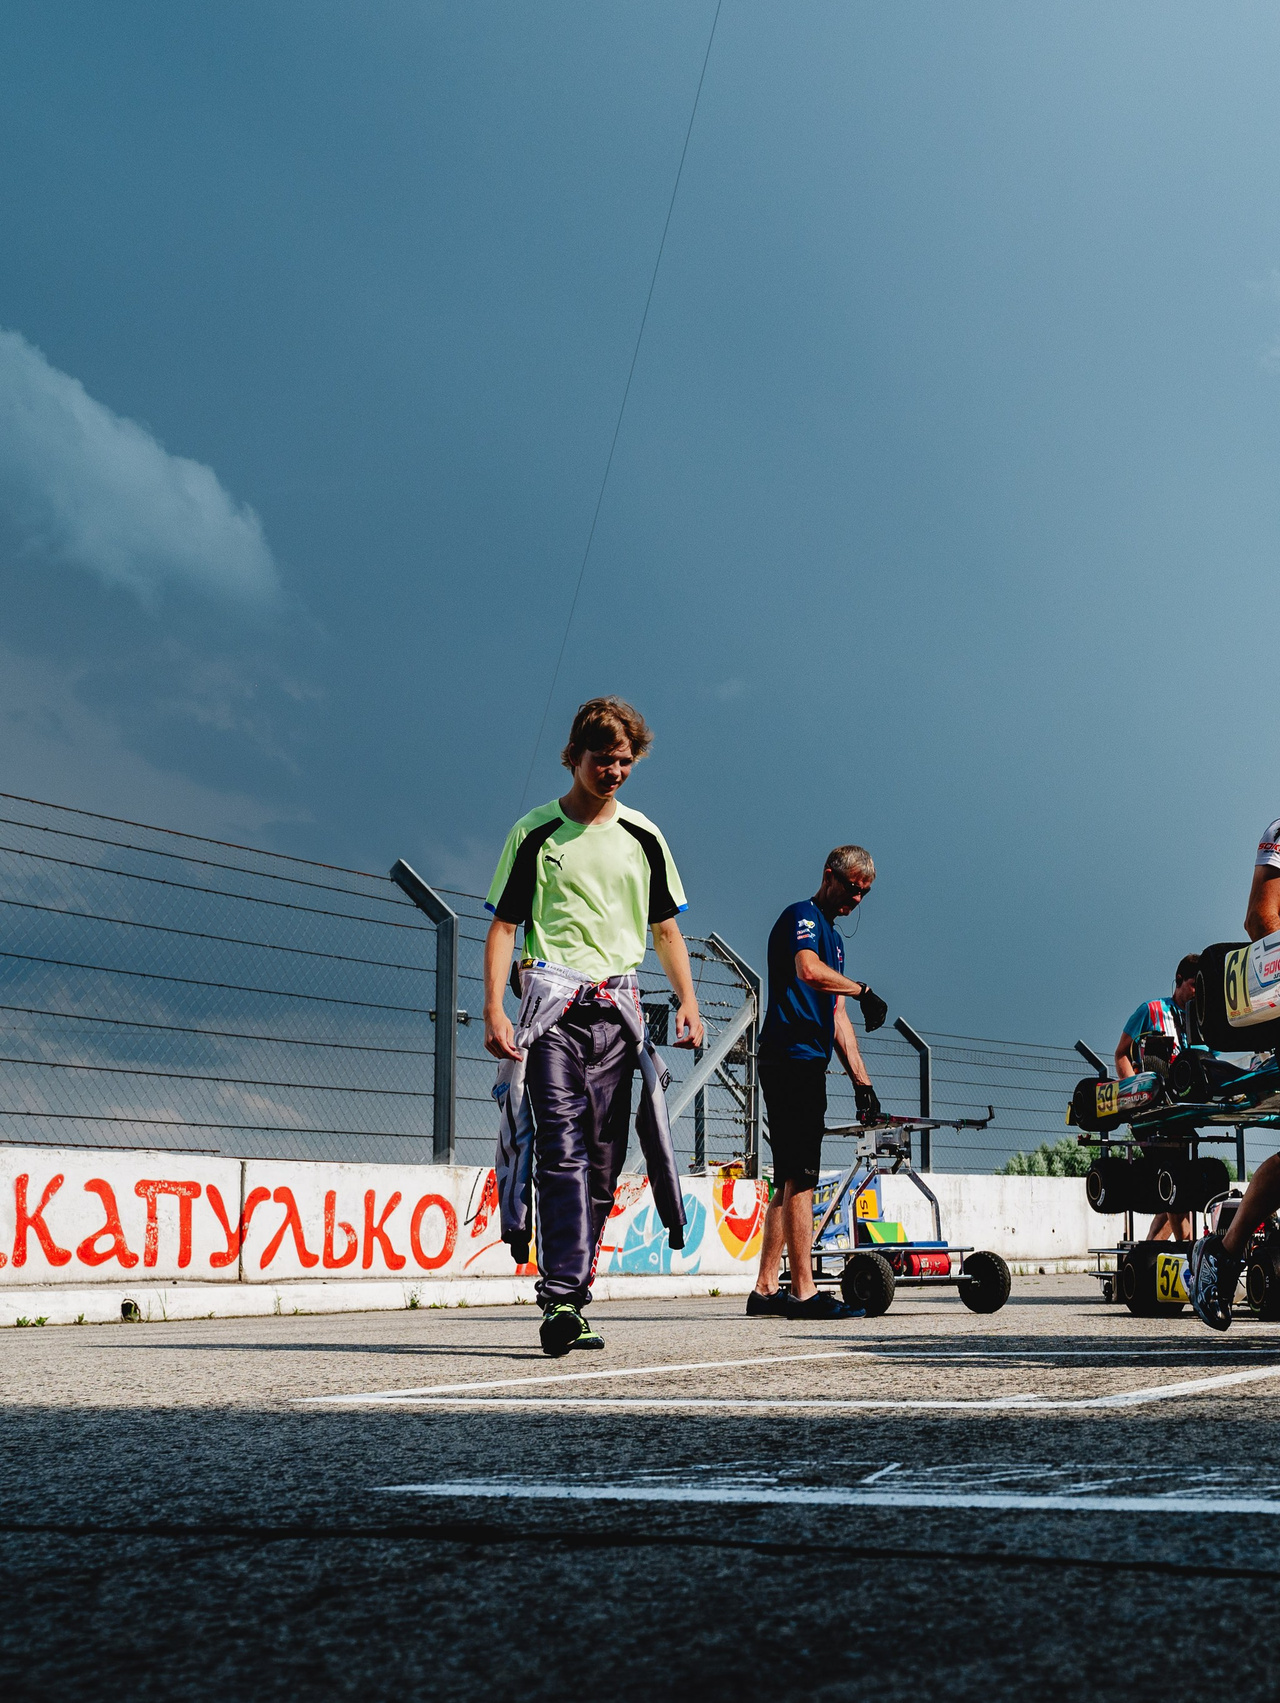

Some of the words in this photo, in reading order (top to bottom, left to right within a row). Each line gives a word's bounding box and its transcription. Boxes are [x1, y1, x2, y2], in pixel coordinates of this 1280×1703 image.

[1226, 946, 1250, 1011] 61
[1097, 1083, 1114, 1113] 59
[1159, 1257, 1180, 1298] 52
